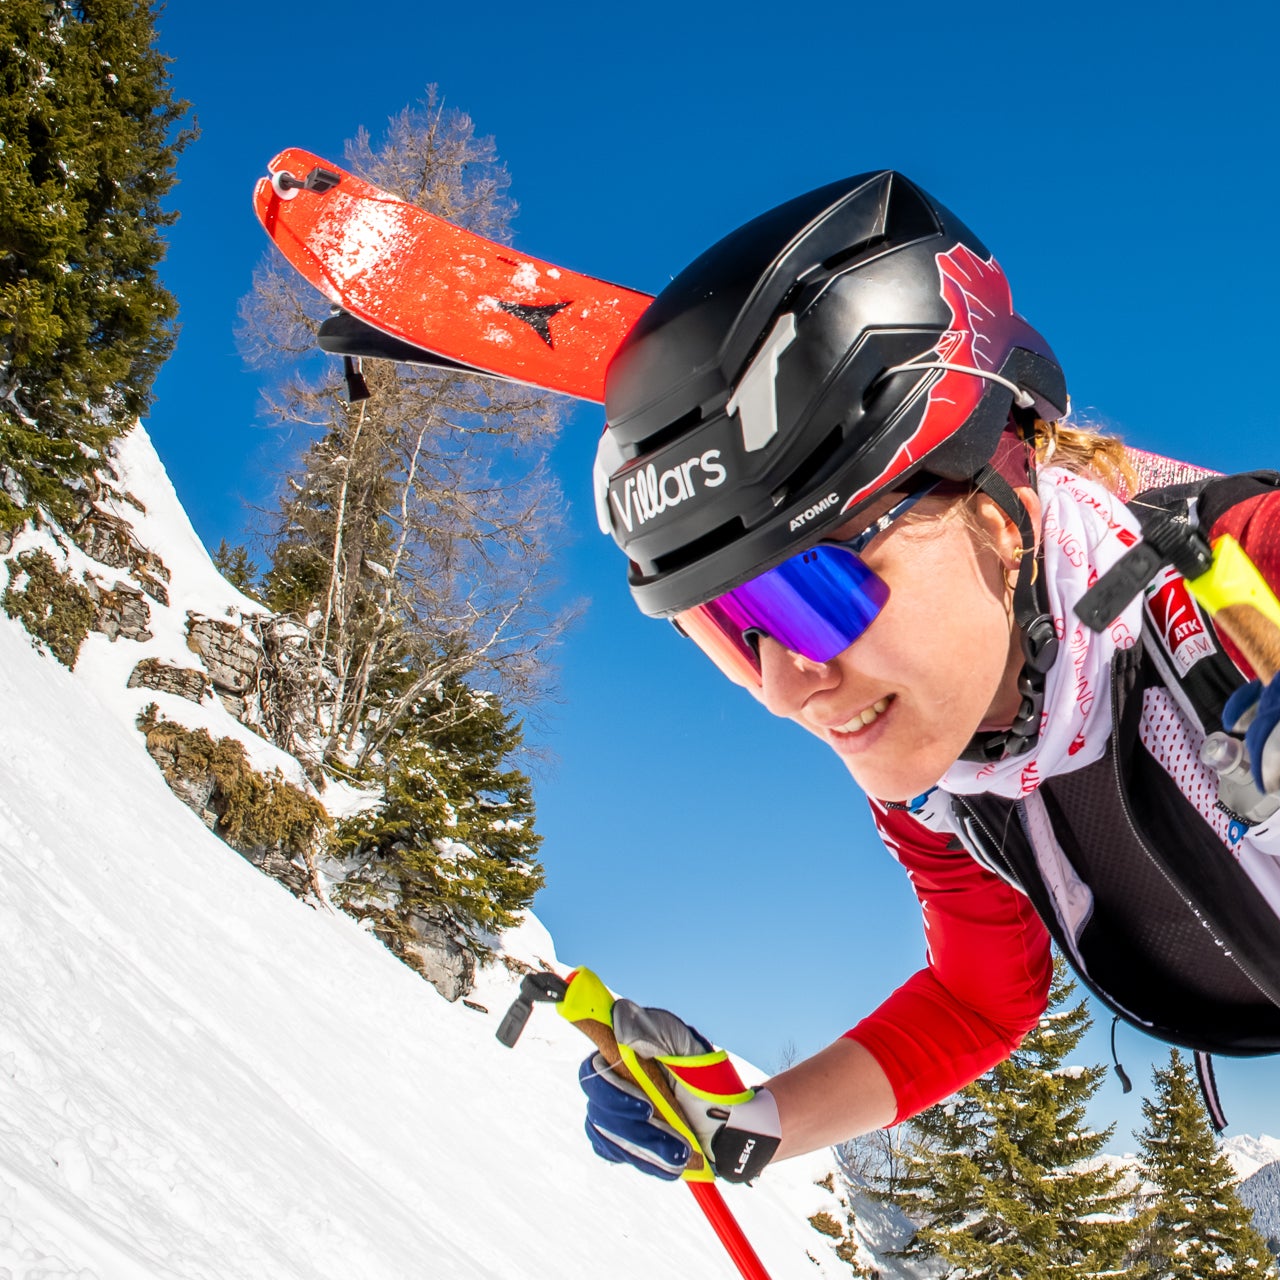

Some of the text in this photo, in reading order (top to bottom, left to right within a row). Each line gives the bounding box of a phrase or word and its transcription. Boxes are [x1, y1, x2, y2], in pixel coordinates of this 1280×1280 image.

[612, 449, 727, 532] Villars
[789, 492, 840, 532] ATOMIC
[1174, 619, 1201, 641] ATK
[733, 1138, 756, 1175] LEKI
